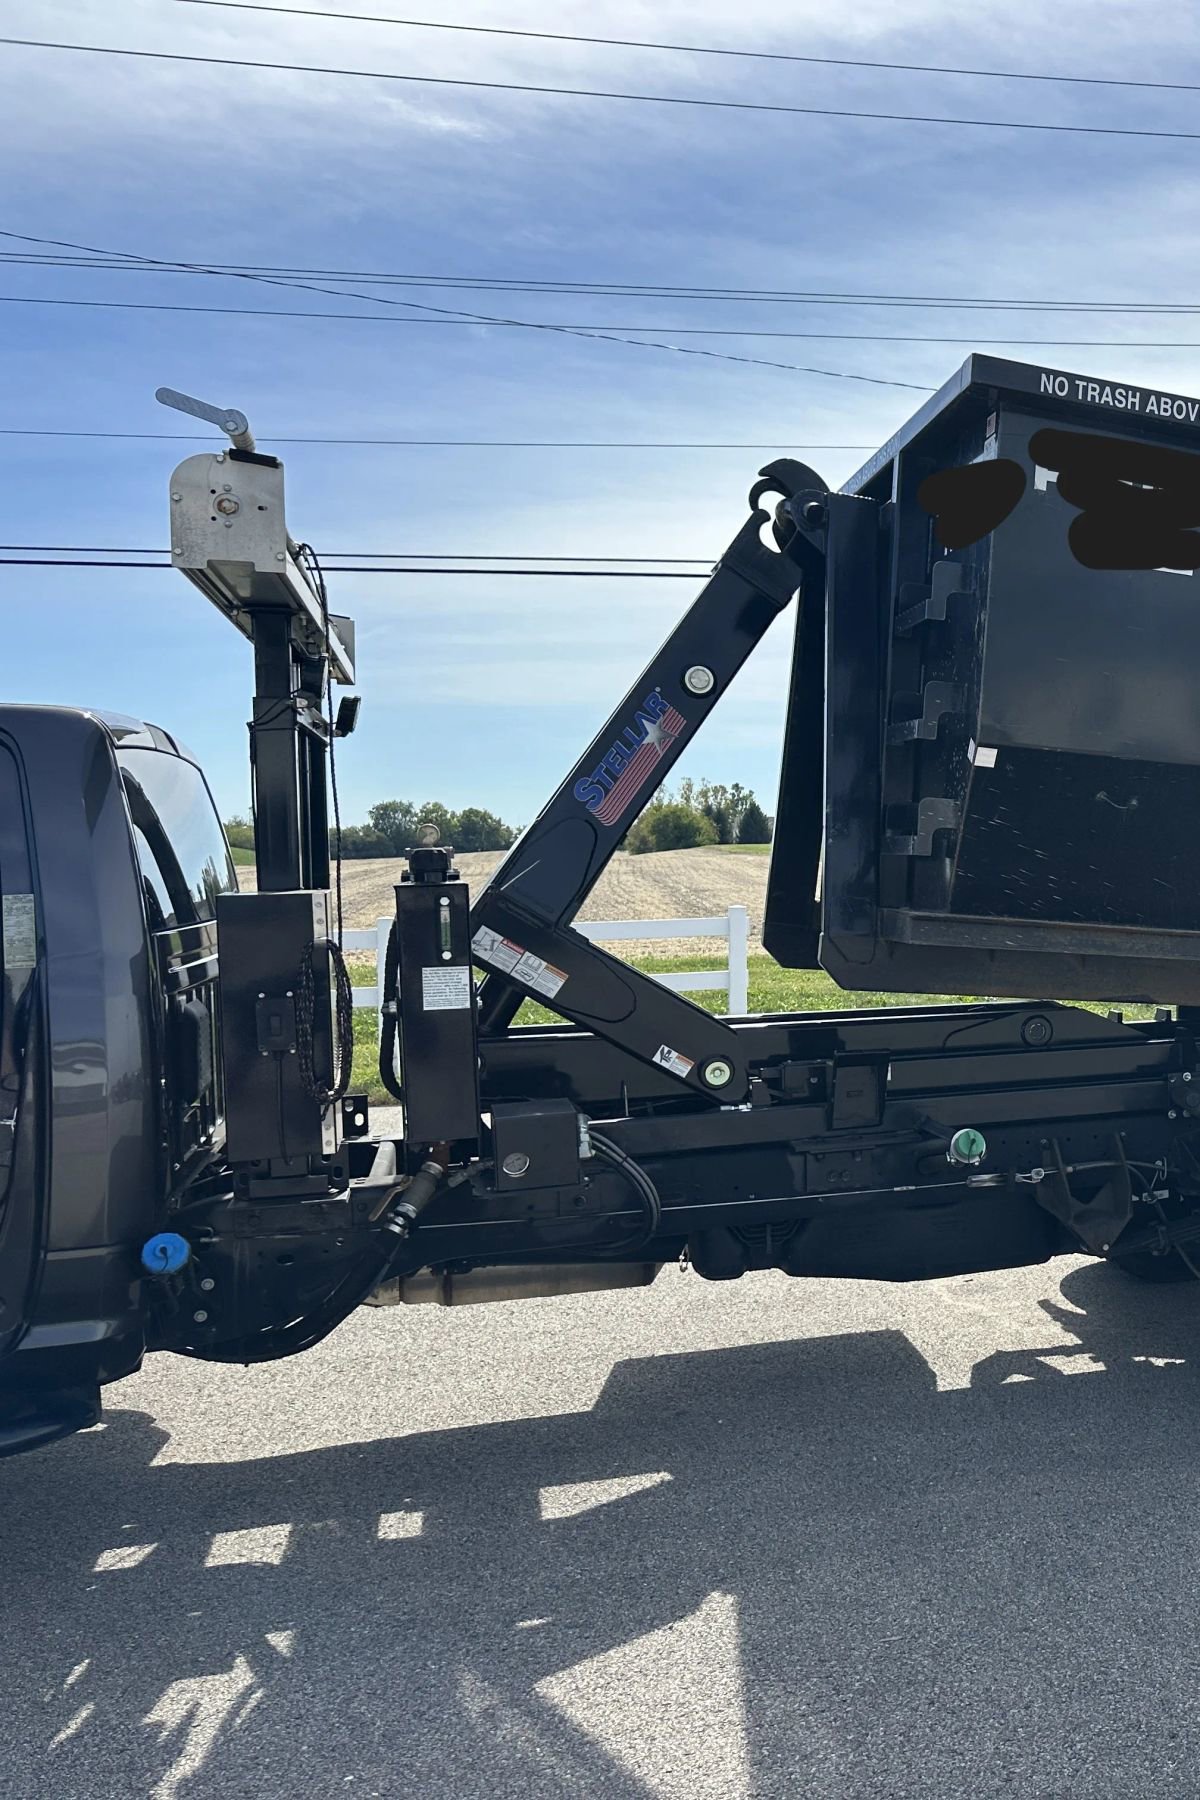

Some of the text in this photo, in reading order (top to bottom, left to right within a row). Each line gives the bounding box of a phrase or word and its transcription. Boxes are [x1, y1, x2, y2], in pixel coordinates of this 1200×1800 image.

[1040, 373, 1069, 396] NO
[1075, 380, 1140, 411] TRASH
[573, 691, 670, 811] STELLAR
